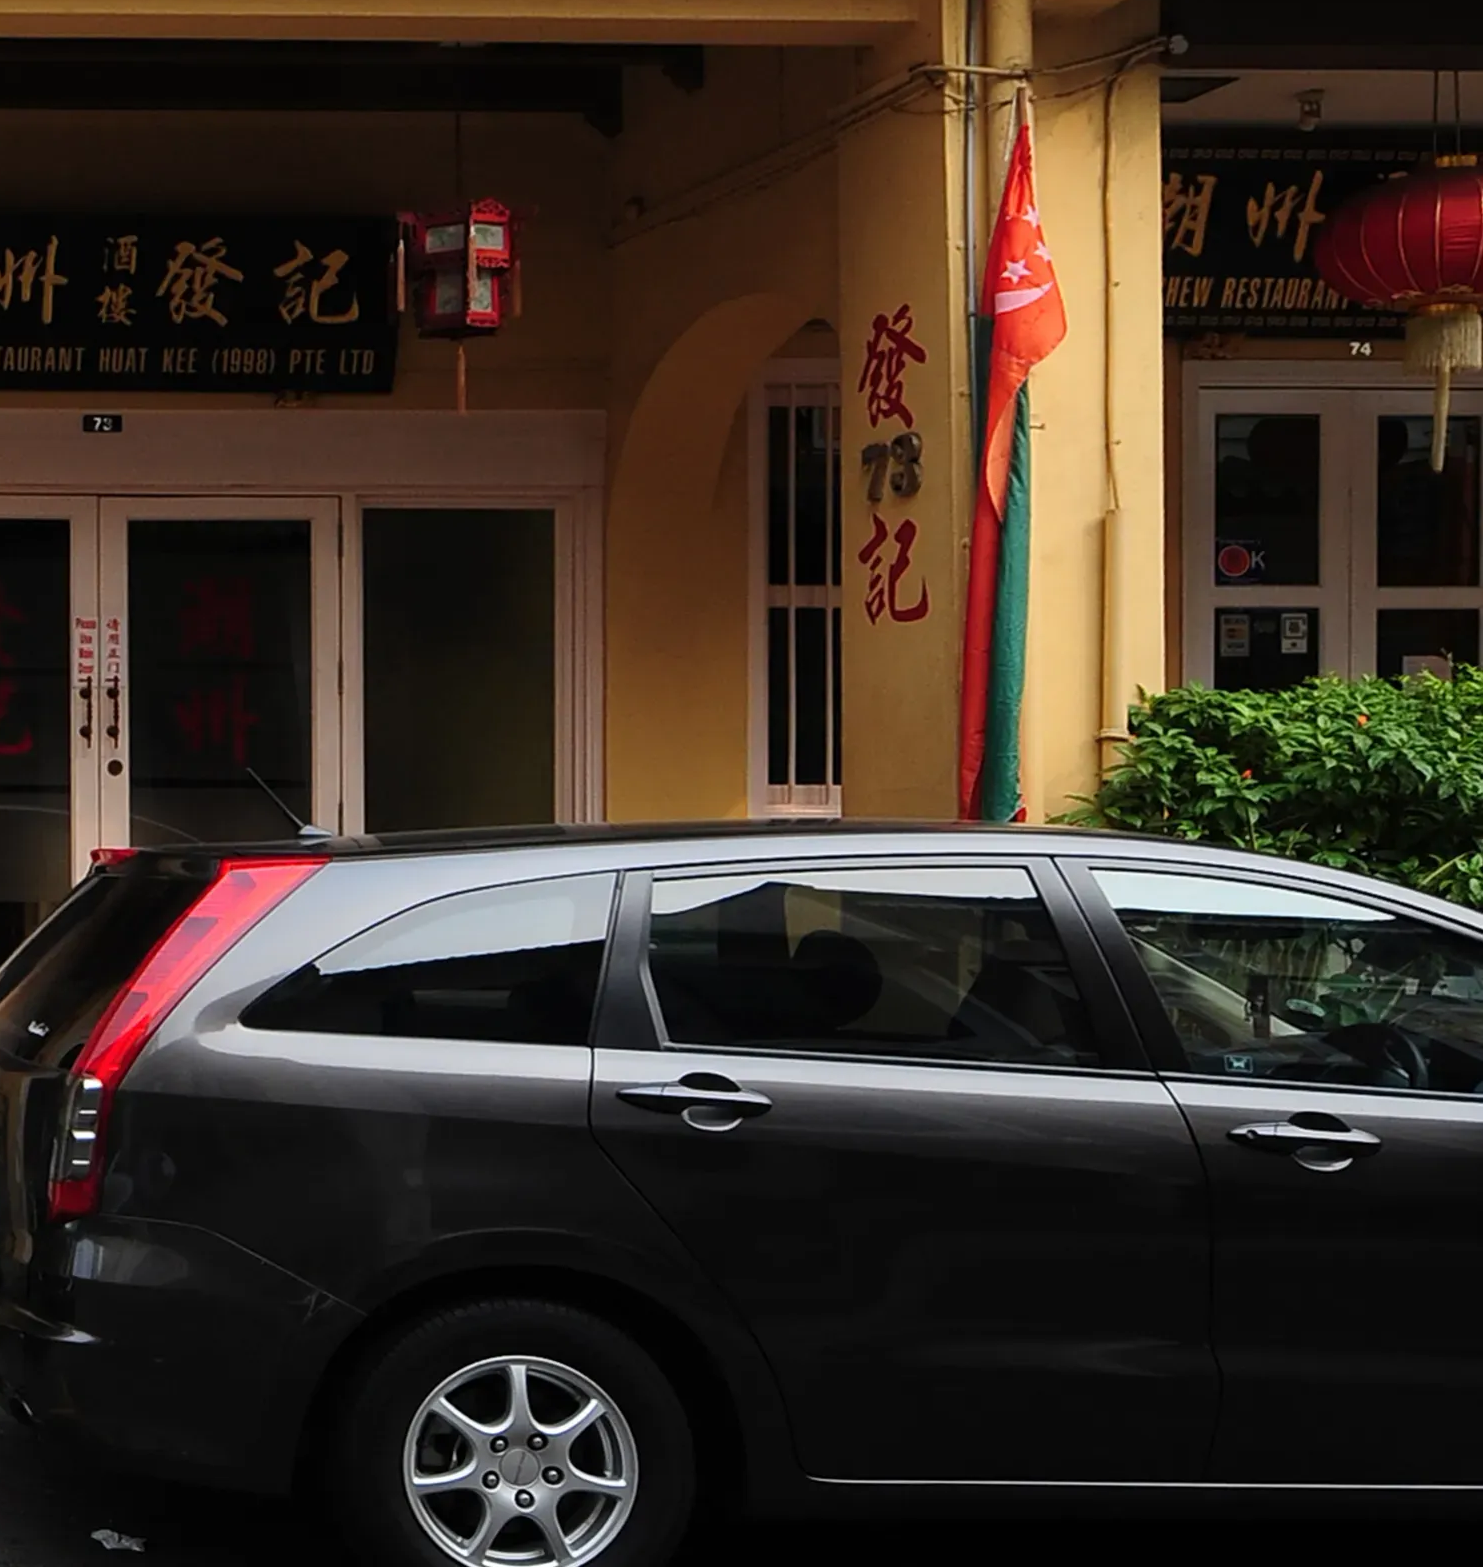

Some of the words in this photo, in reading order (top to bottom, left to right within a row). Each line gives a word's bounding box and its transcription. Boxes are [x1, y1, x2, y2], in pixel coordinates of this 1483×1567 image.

[1349, 341, 1373, 357] 74
[97, 346, 150, 374] HUAT
[161, 347, 198, 374] KEE
[211, 347, 277, 375] (1998)
[288, 348, 326, 375] PTE
[338, 348, 376, 376] LTD
[92, 416, 114, 432] 73
[861, 431, 923, 503] 73
